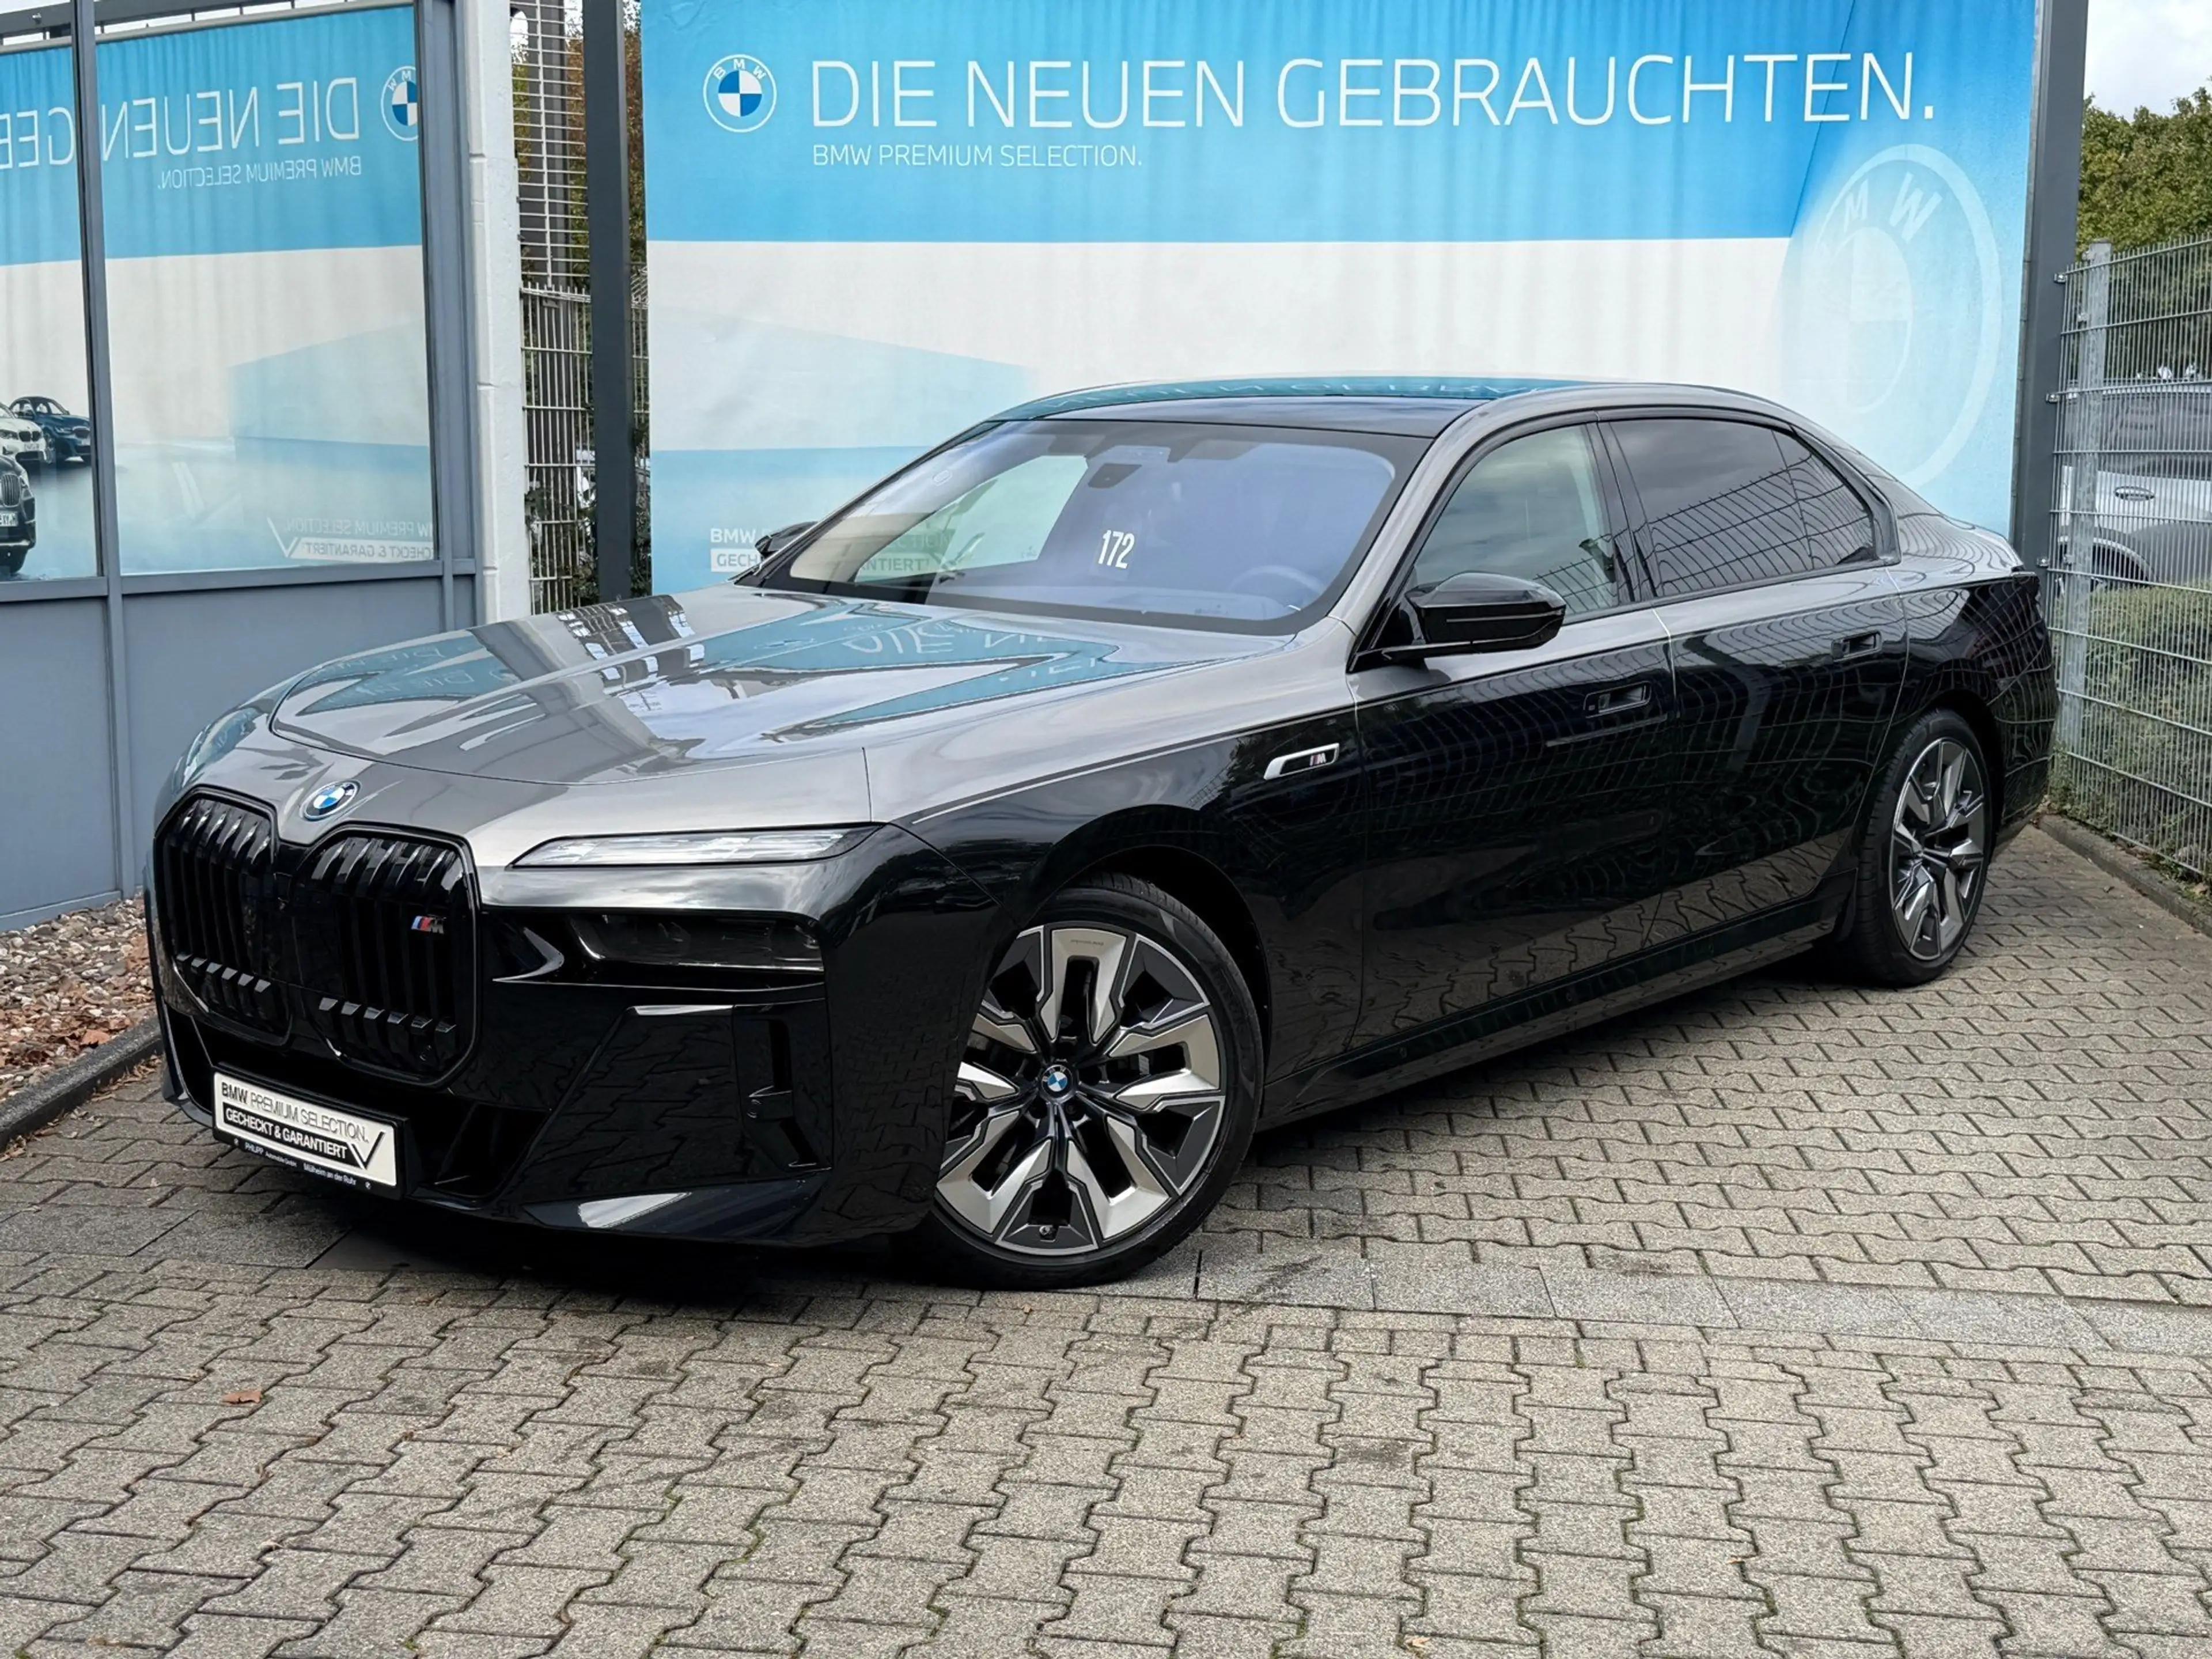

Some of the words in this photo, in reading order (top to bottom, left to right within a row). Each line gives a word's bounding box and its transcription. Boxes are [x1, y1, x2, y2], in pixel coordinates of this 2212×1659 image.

[713, 58, 767, 80] BMW
[812, 60, 938, 128] DIE
[967, 60, 1244, 129] NEUEN
[1275, 52, 1934, 128] GEBRAUCHTEN.
[813, 144, 872, 166] BMW
[879, 144, 994, 166] PREMIUM
[999, 144, 1143, 166] SELECTION.
[710, 528, 756, 544] BMW
[1098, 529, 1135, 569] 172
[221, 1081, 248, 1104] BMW
[250, 1092, 299, 1123] PREMIUM
[300, 1108, 369, 1143] SELECTION.
[225, 1108, 274, 1136] GECHECKT
[274, 1124, 282, 1139] &
[282, 1130, 347, 1159] GARANTIERT
